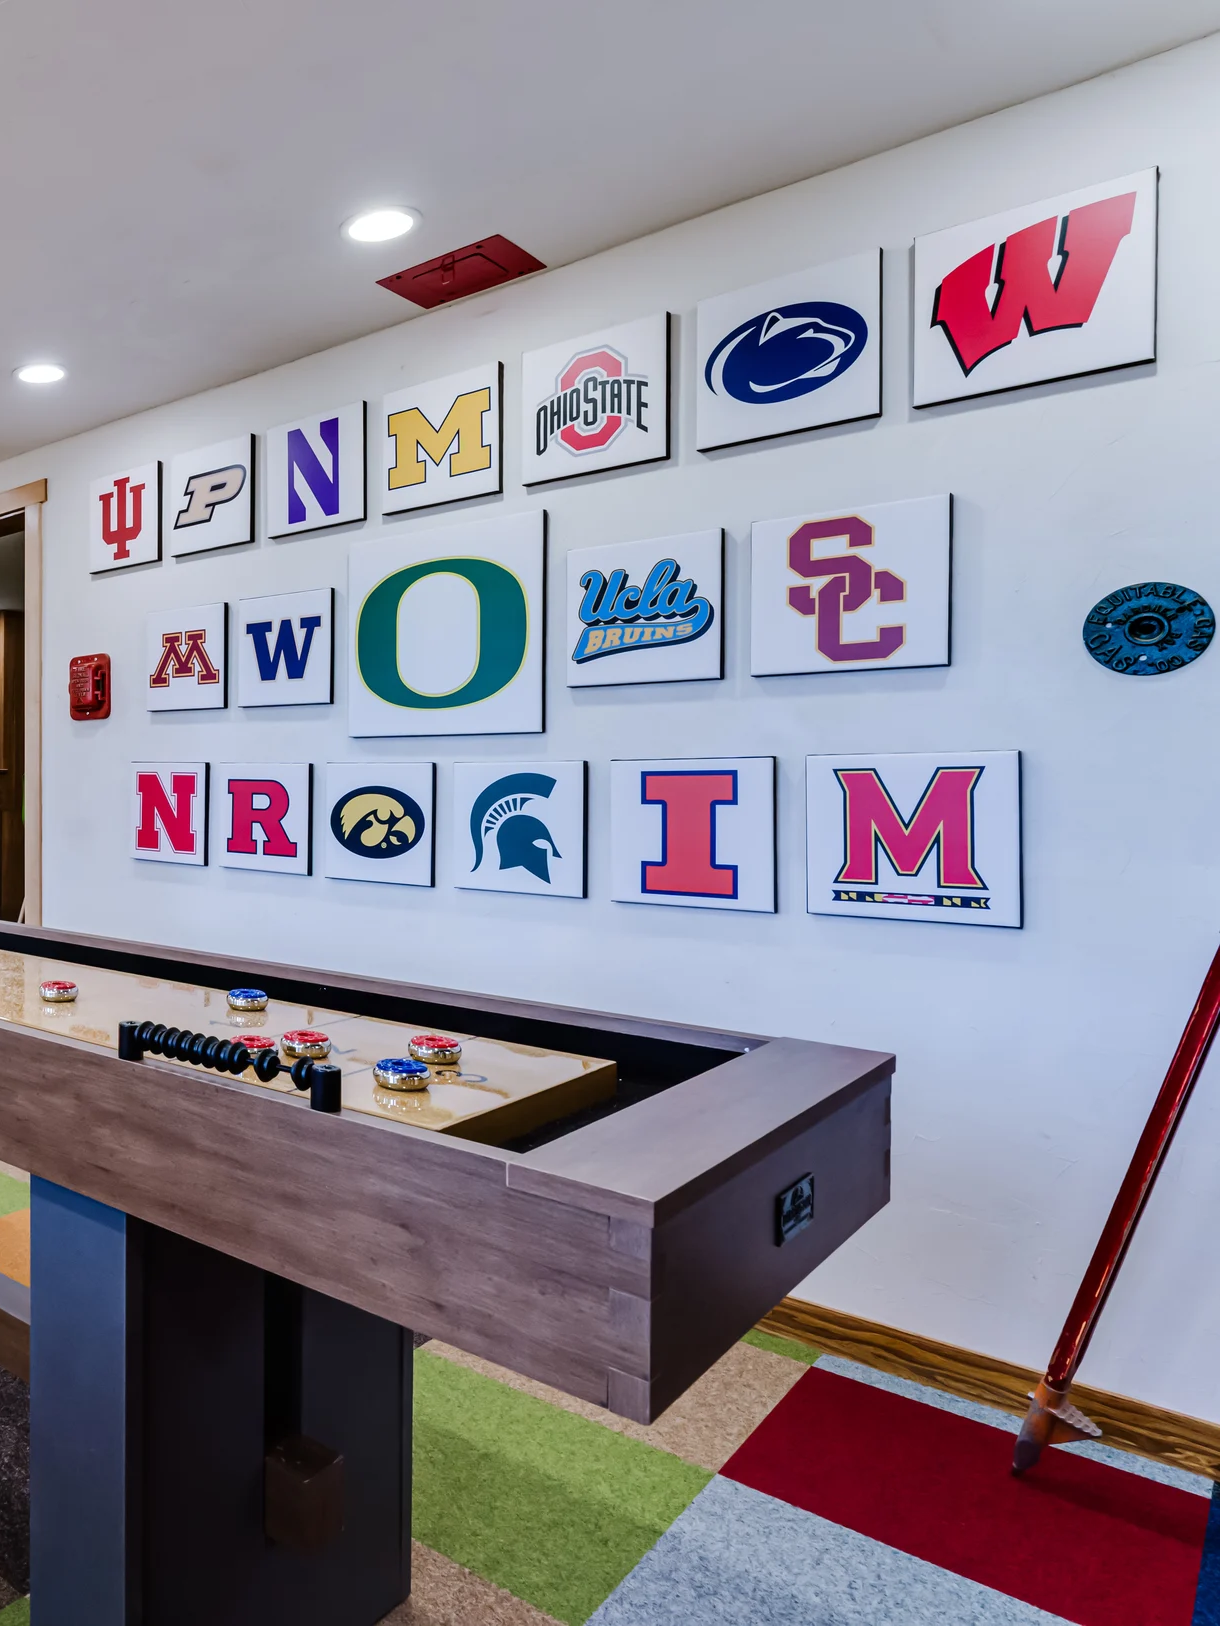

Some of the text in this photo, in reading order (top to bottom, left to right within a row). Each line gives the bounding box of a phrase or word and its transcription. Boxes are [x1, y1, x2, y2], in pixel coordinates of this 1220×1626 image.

[930, 191, 1137, 378] W
[387, 386, 492, 491] M
[536, 376, 648, 456] OHIO STATE
[173, 463, 247, 530] P
[287, 416, 339, 525] N
[355, 555, 529, 711] O
[583, 622, 693, 655] BRUINS
[1087, 583, 1206, 625] EQUITABLE
[149, 628, 220, 688] M
[246, 614, 322, 682] W
[135, 771, 198, 856] N
[226, 778, 298, 858] R
[641, 770, 738, 900] I
[832, 764, 989, 891] M
